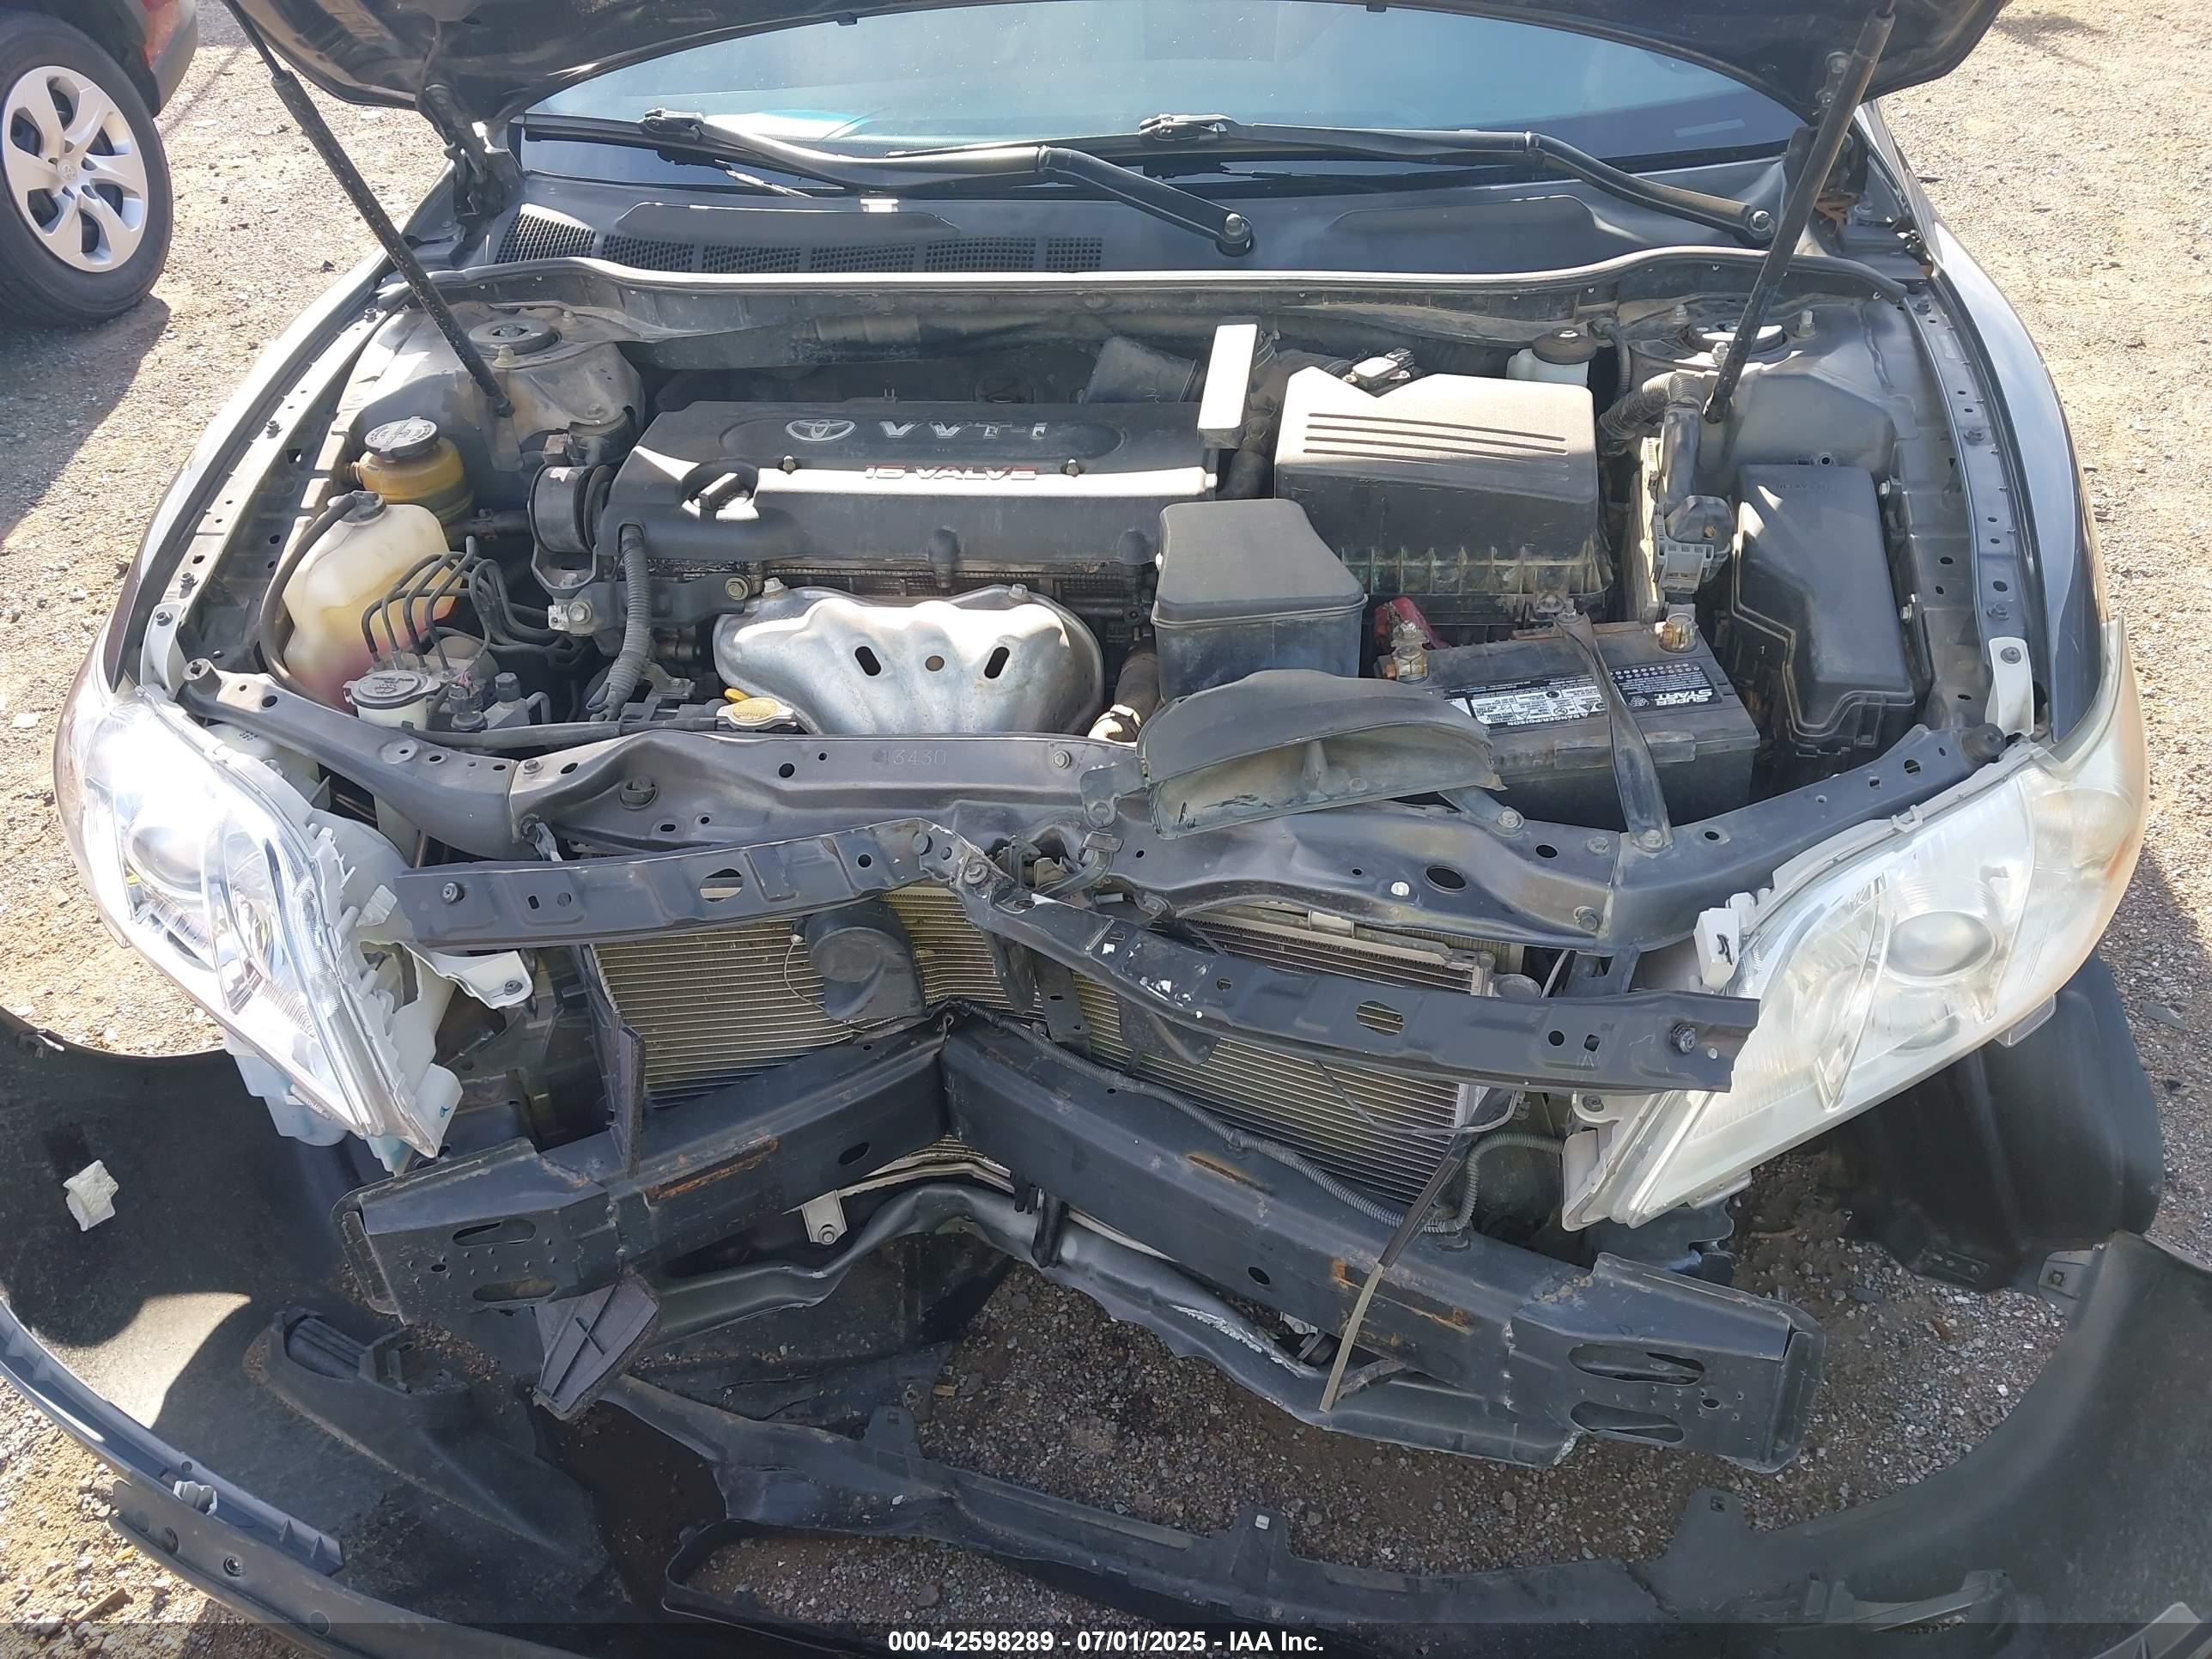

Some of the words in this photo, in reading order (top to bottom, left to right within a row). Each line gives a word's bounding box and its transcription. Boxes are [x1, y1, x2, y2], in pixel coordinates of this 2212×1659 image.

[866, 465, 907, 479] 16
[915, 465, 1038, 481] VALVE
[1654, 689, 1713, 701] START
[1656, 696, 1709, 707] SUPER
